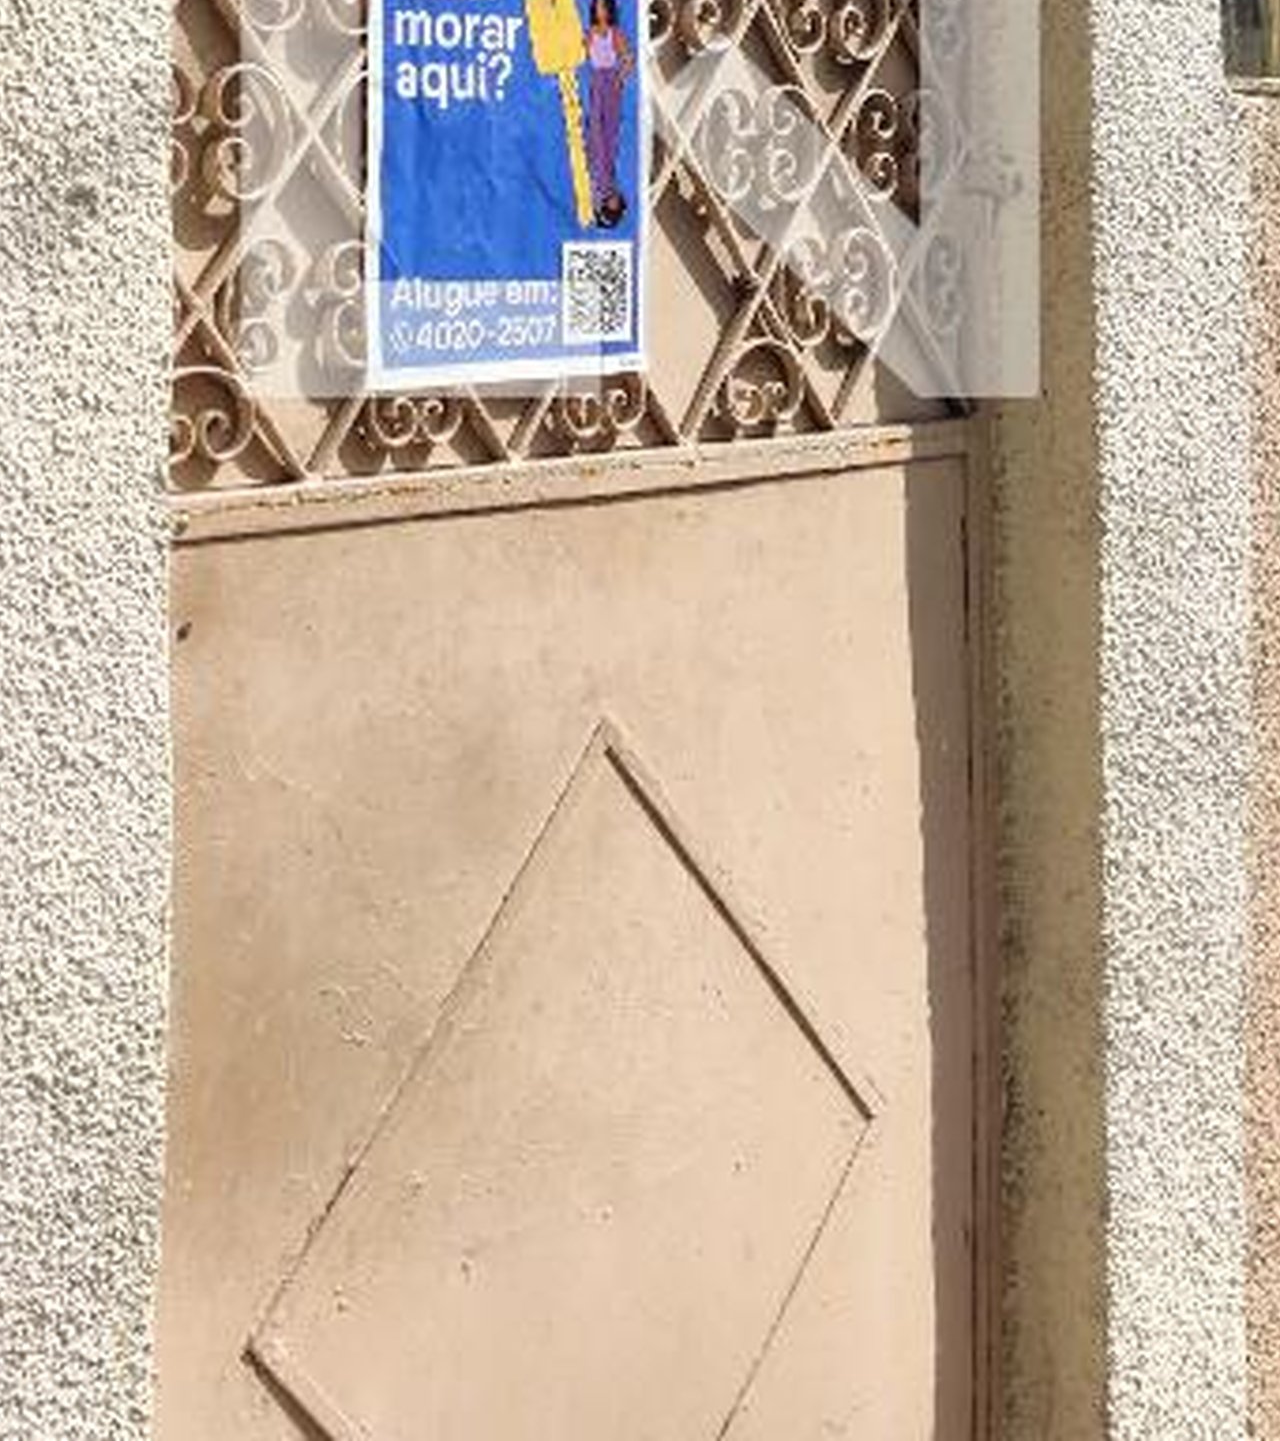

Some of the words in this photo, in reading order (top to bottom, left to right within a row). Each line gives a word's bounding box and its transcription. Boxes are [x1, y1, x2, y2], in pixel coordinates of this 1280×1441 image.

[393, 9, 524, 52] morar
[395, 51, 513, 110] aqui?
[390, 276, 498, 317] Alugue
[505, 279, 558, 305] em:
[416, 315, 558, 350] 4020-2507
